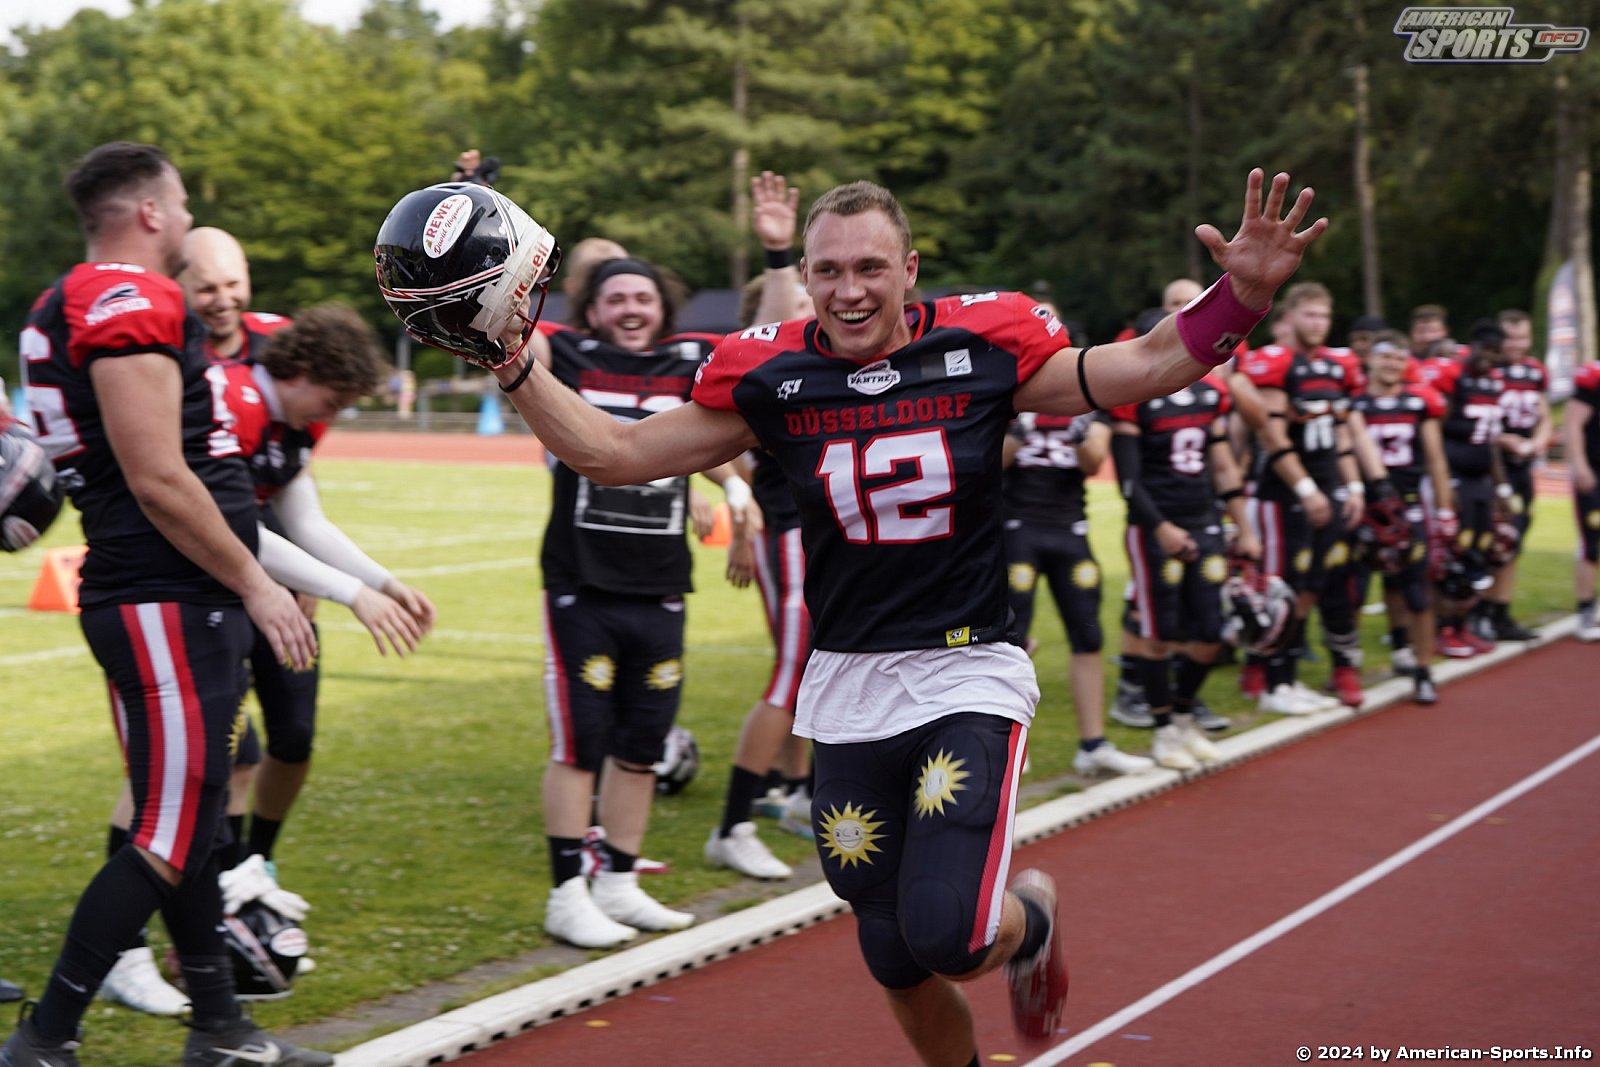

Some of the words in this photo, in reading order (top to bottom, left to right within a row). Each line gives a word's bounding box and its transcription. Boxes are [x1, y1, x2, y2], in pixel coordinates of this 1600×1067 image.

[425, 202, 453, 239] REWE
[784, 393, 972, 436] DÜSSELDORF
[815, 426, 955, 544] 12
